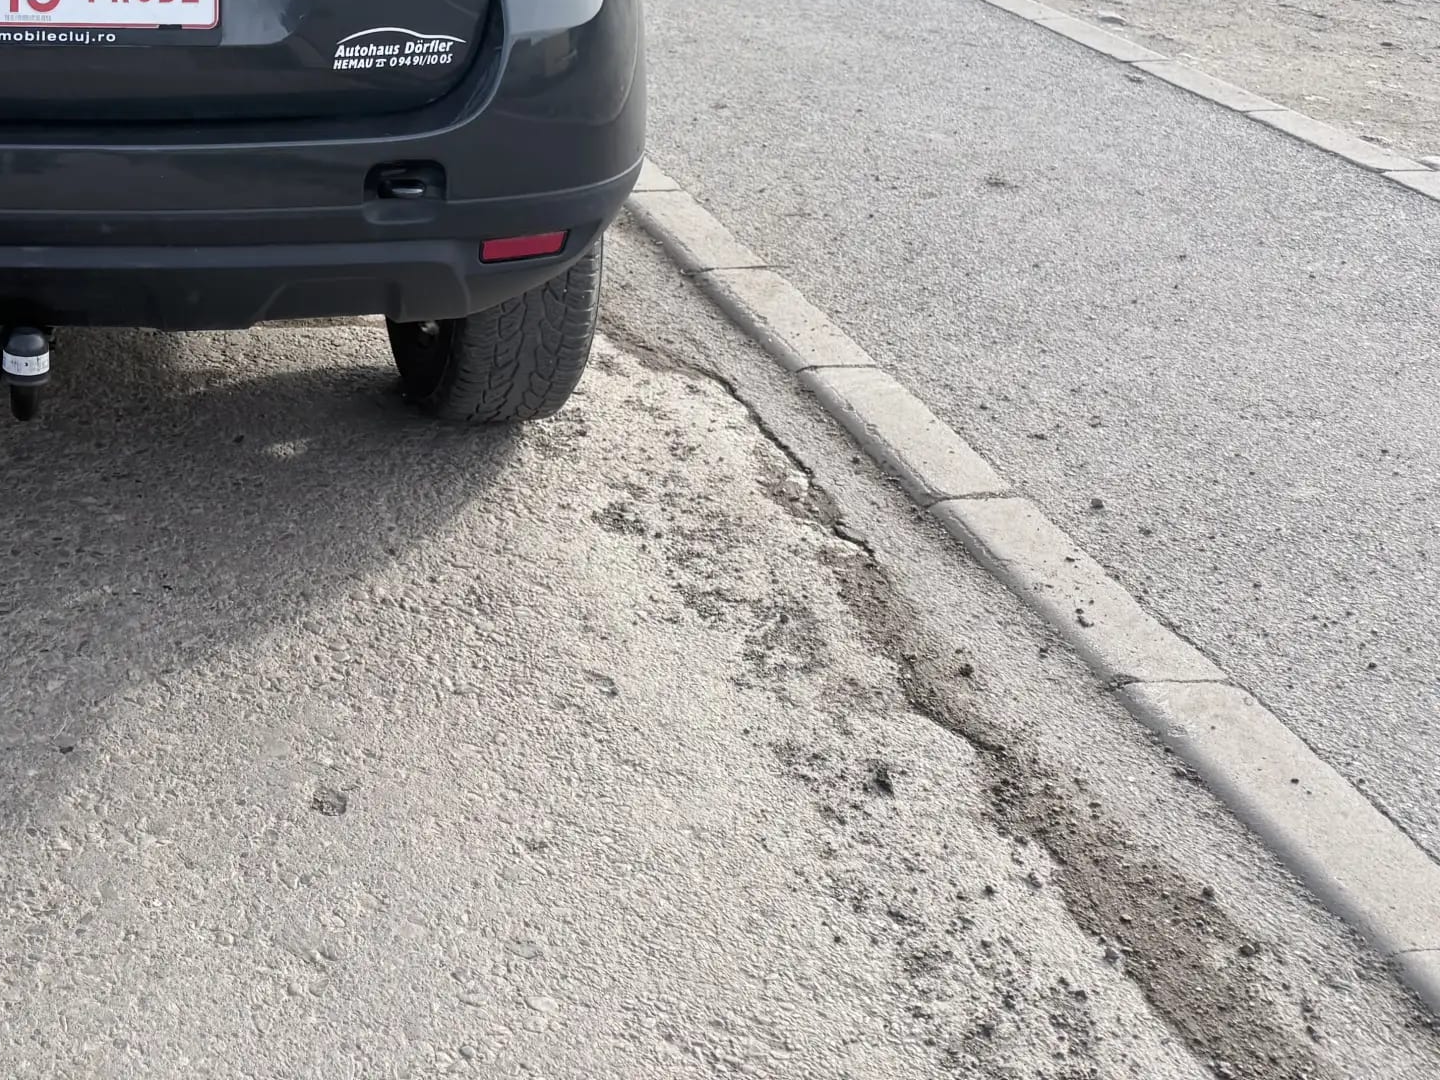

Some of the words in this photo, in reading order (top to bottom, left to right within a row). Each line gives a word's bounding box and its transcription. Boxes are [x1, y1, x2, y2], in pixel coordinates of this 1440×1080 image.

[334, 43, 400, 58] Autohaus
[404, 39, 454, 54] Dörfler
[333, 58, 374, 70] HEMAU
